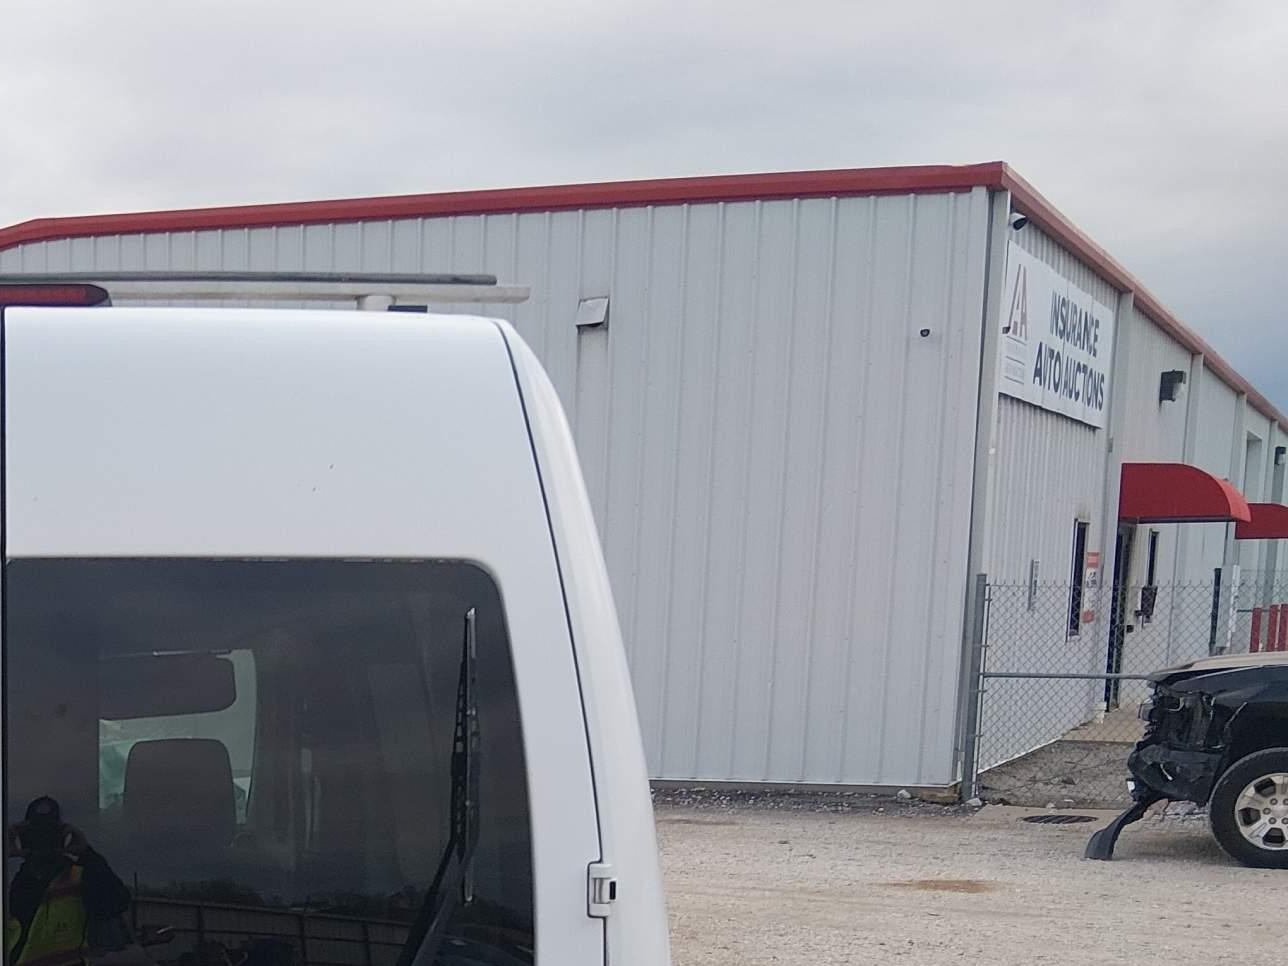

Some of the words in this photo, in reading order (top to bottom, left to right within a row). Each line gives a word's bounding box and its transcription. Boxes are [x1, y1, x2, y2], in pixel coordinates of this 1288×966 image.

[1049, 289, 1100, 358] INSURANCE
[1032, 340, 1062, 394] AUTO
[1062, 354, 1105, 411] AUCTIONS
